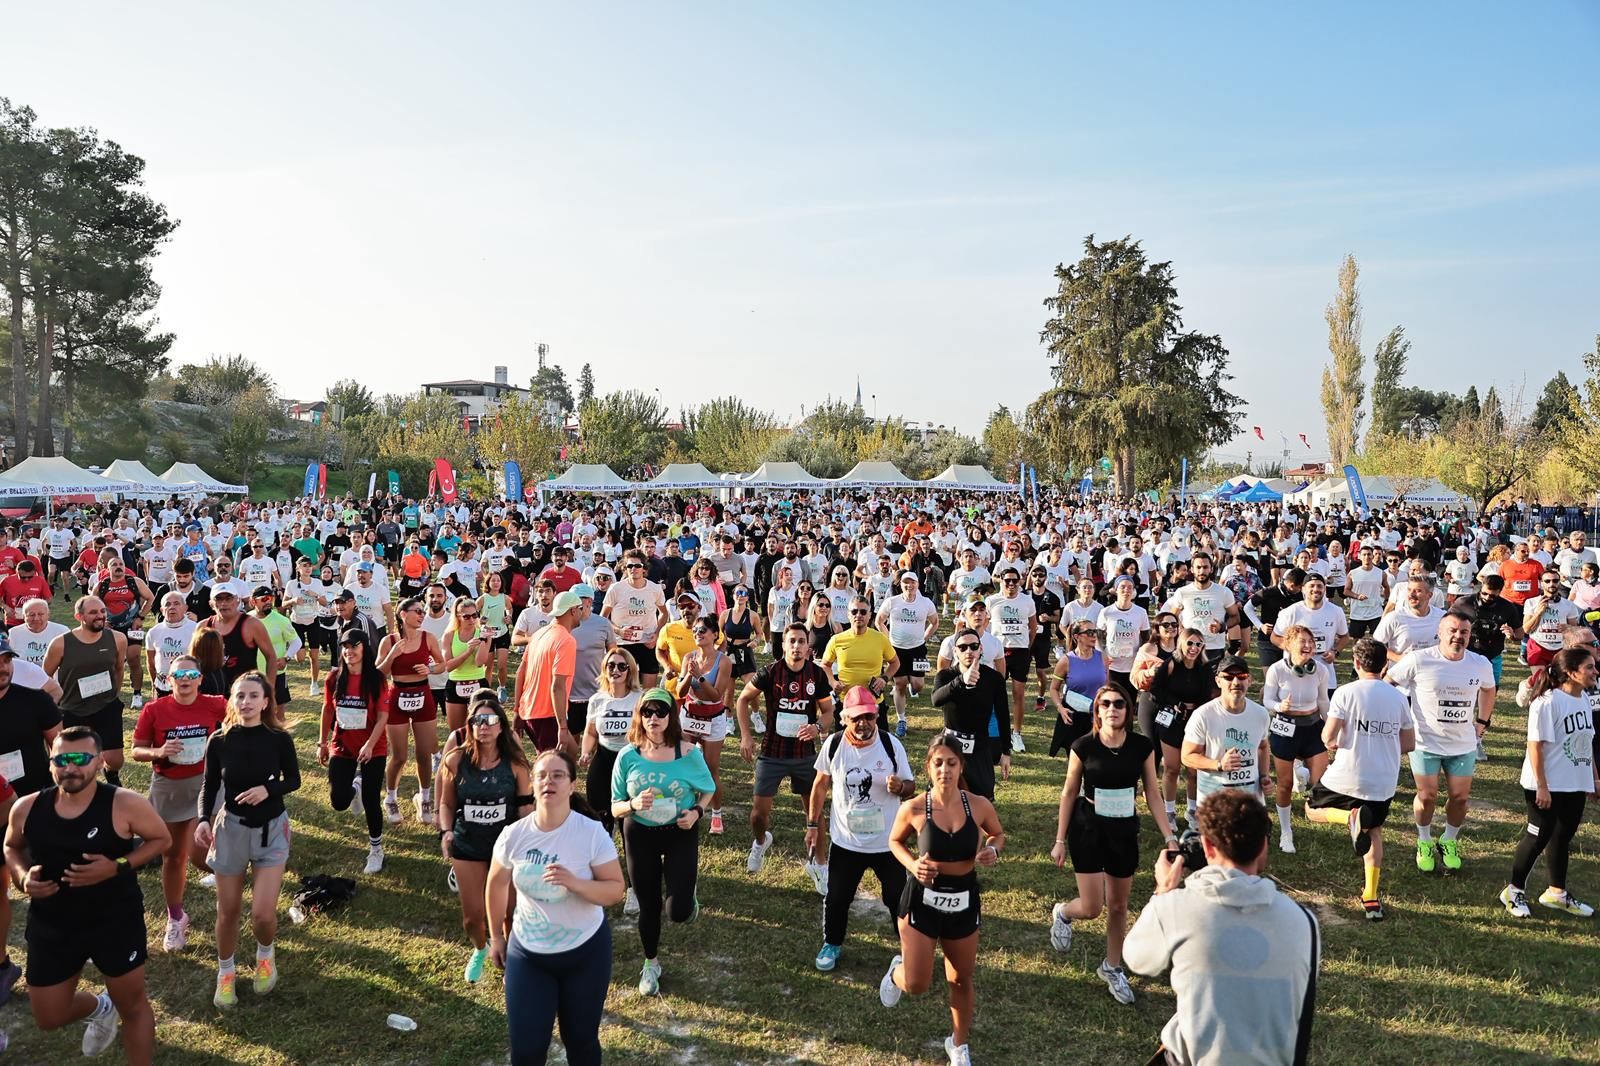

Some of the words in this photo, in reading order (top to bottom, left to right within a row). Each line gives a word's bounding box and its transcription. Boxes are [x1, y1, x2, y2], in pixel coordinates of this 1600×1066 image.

[402, 699, 421, 708] 1782
[1443, 709, 1467, 718] 1660
[605, 720, 628, 730] 1780
[689, 721, 706, 731] 202
[1272, 721, 1289, 733] 636
[167, 728, 207, 738] RUNNERS
[1227, 770, 1251, 780] 1302
[471, 808, 500, 819] 1466
[932, 896, 960, 908] 1713
